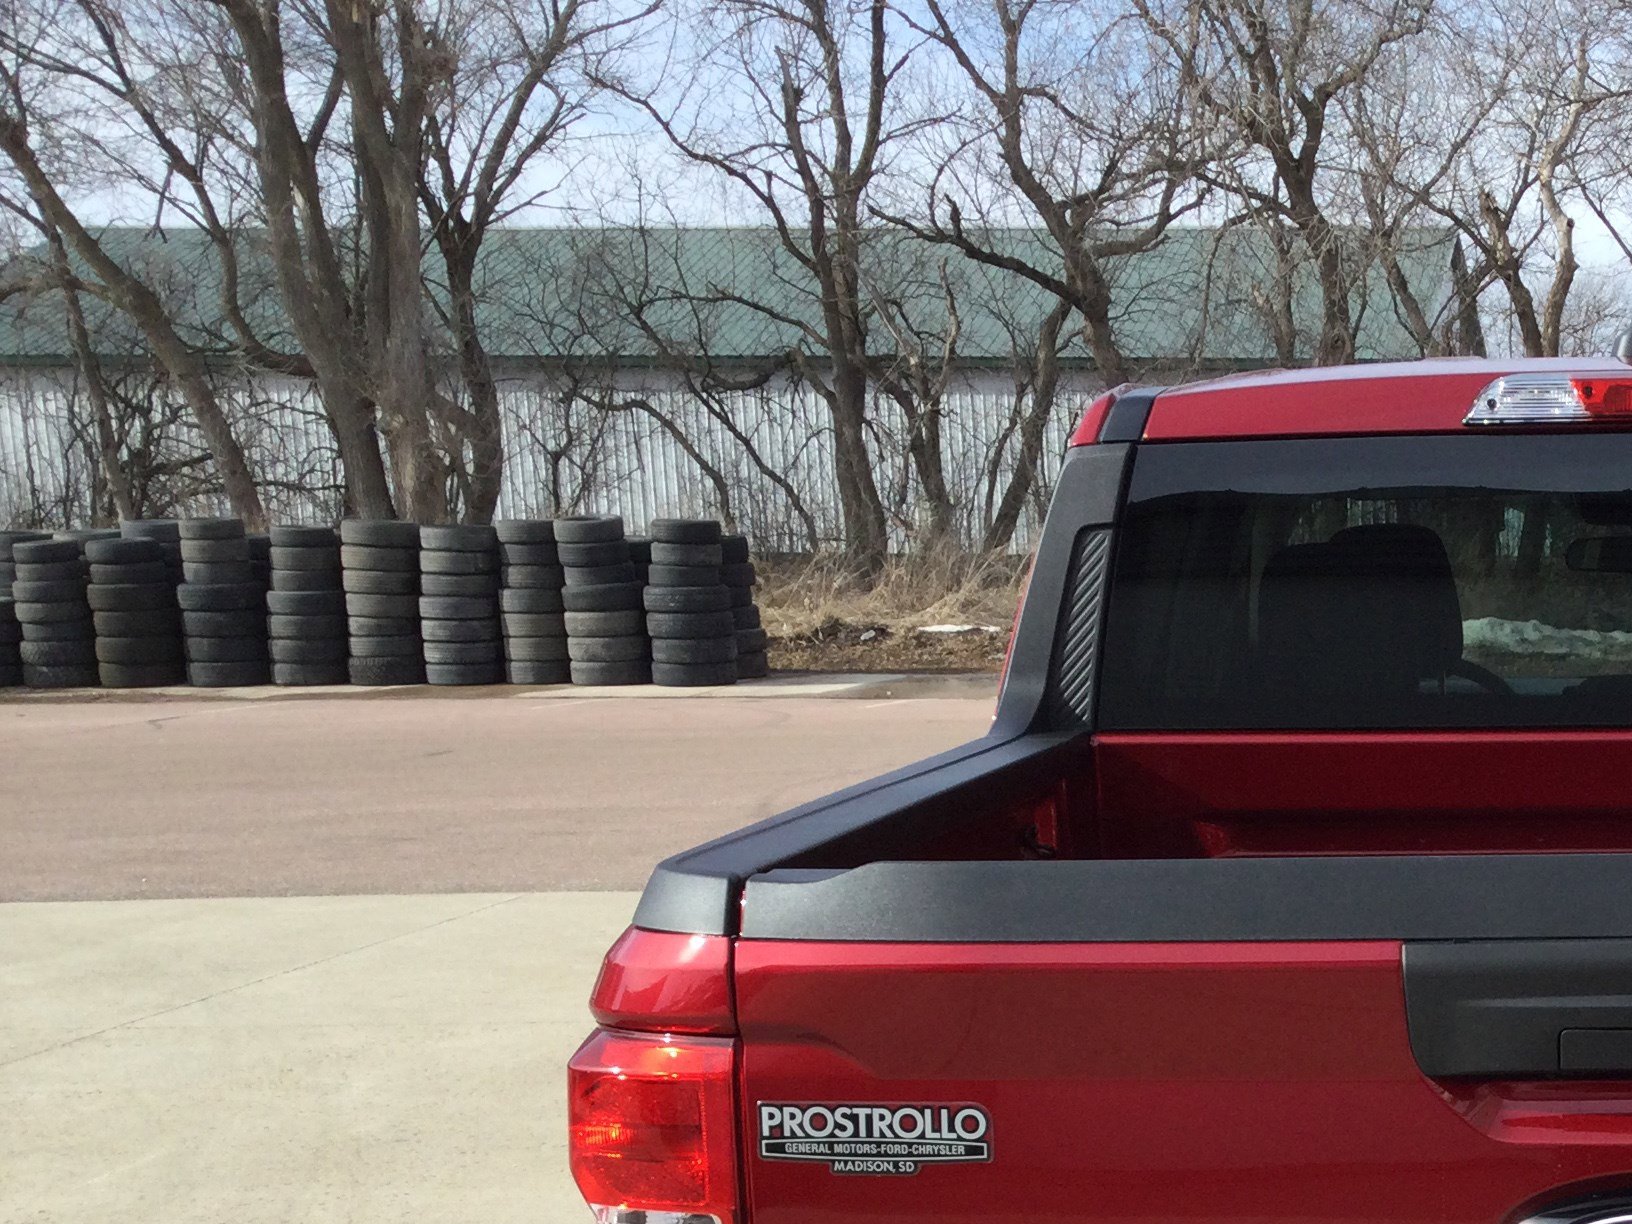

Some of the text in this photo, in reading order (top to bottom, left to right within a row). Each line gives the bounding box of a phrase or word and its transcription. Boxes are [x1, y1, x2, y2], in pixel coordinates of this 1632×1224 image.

[760, 1105, 988, 1140] PROSTROLLO
[785, 1142, 965, 1156] GENERAL MOTORS-FORD-CHRYSLER
[833, 1161, 915, 1173] MADISON, SD
